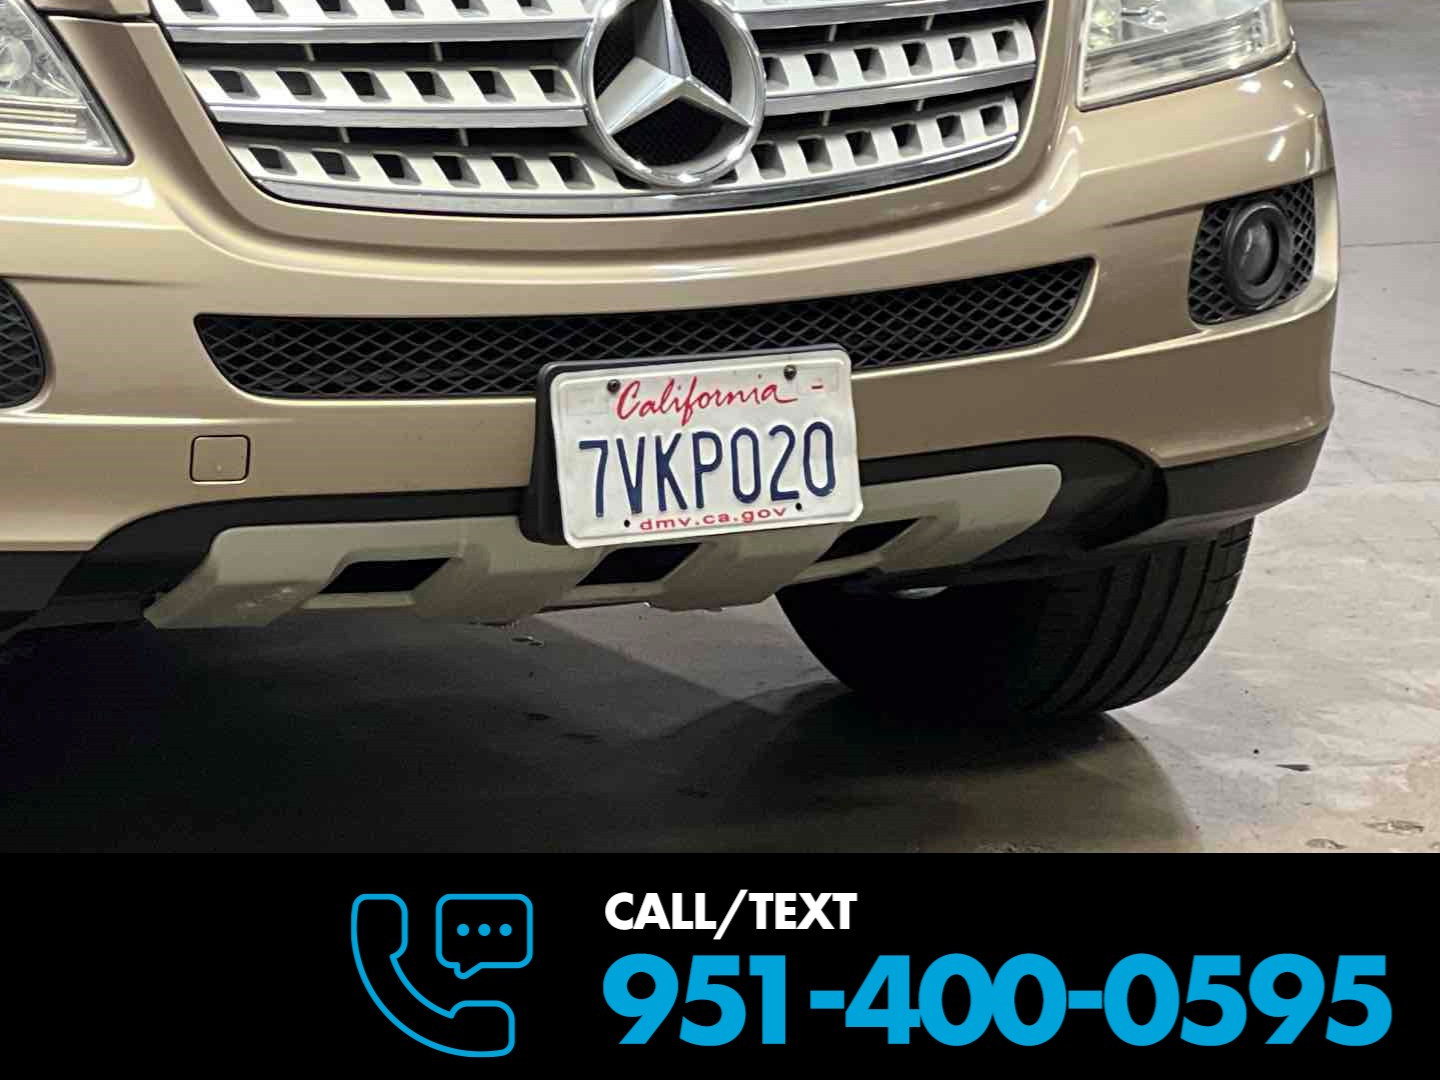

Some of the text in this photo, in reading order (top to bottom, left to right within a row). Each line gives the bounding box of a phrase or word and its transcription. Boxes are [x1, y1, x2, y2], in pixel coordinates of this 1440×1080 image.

[613, 375, 799, 426] California
[578, 421, 837, 518] 7VKP020
[639, 505, 787, 532] dmv.ca.gov
